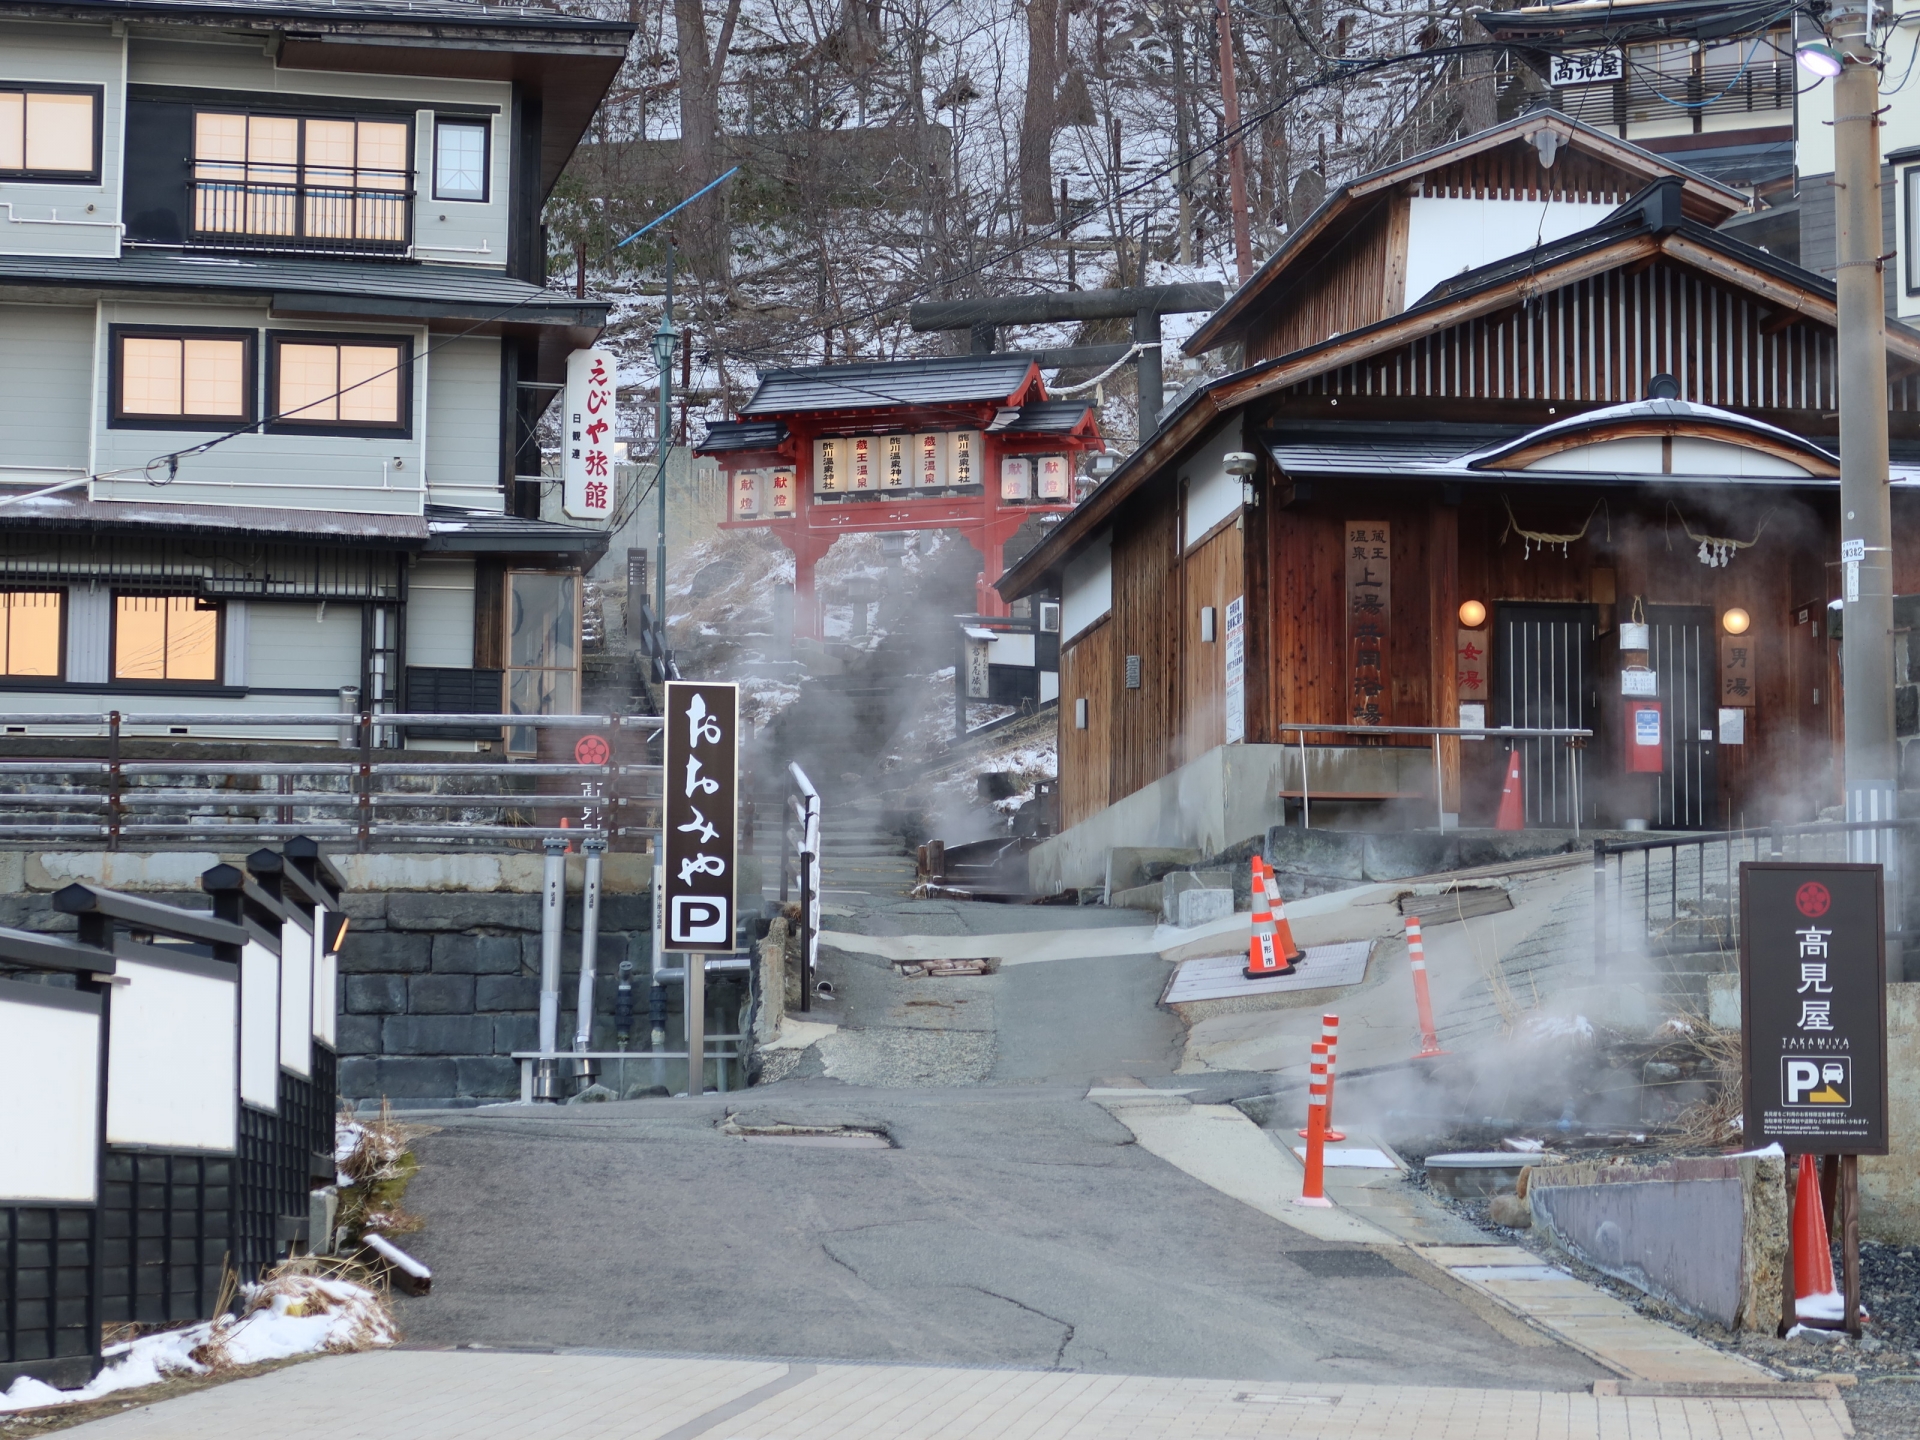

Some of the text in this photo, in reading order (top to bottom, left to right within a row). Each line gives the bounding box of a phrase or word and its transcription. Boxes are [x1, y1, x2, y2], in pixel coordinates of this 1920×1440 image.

[571, 413, 581, 459] 日観連
[584, 358, 611, 509] えびや旅館
[855, 439, 869, 488] 蔵王温泉
[923, 436, 937, 484] 蔵王温泉
[772, 476, 788, 508] 献燈
[1350, 530, 1369, 560] 温泉
[1370, 529, 1388, 560] 蔵王
[1353, 567, 1385, 726] 上湯共同浴場
[1458, 641, 1483, 690] 女湯
[1726, 647, 1751, 697] 男湯
[679, 901, 721, 937] P
[1262, 934, 1273, 966] 山形市
[1795, 925, 1834, 1031] 高見屋
[1782, 1037, 1849, 1046] TAKAMIYA
[1788, 1061, 1820, 1103] P
